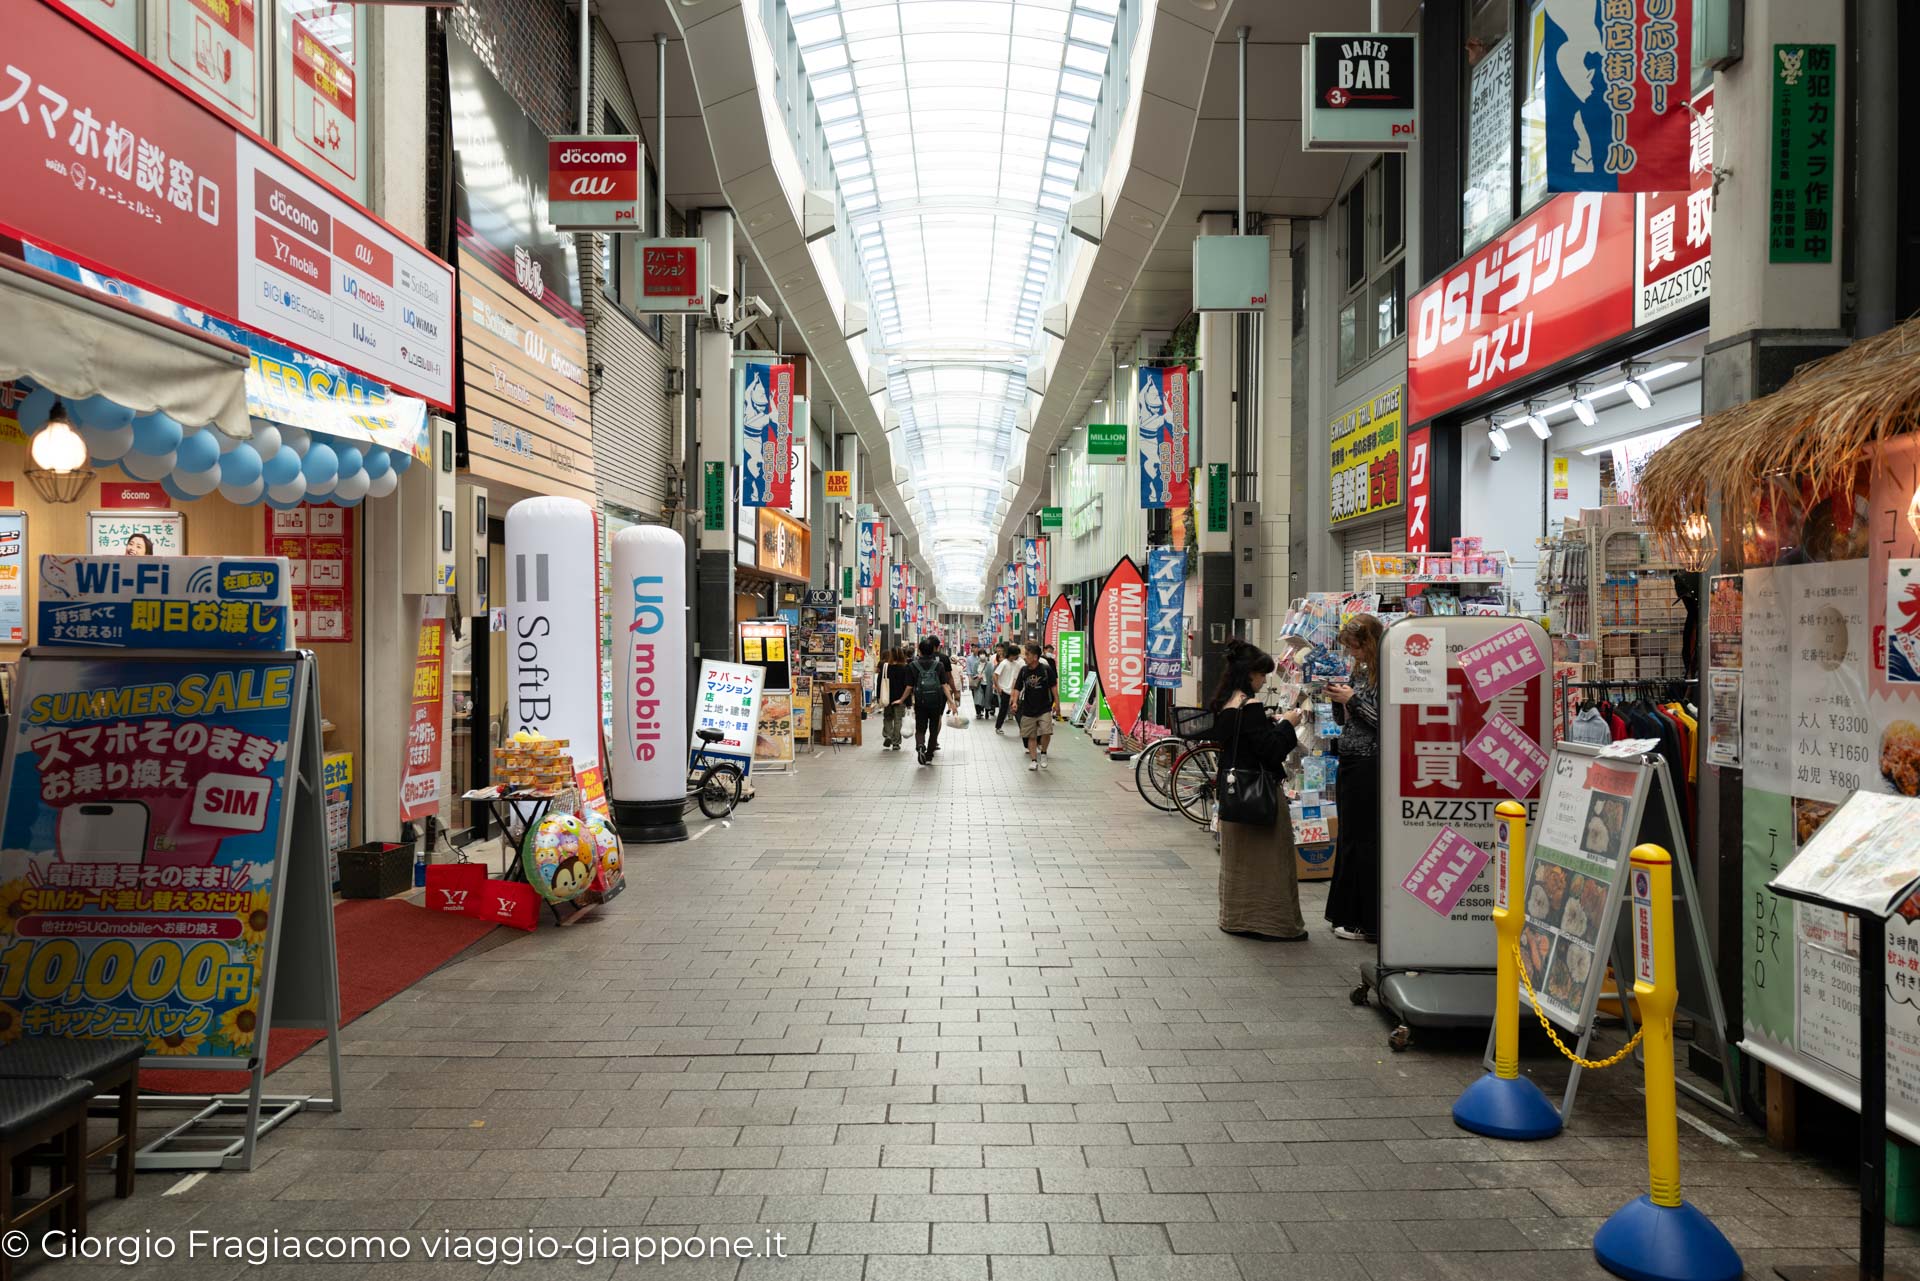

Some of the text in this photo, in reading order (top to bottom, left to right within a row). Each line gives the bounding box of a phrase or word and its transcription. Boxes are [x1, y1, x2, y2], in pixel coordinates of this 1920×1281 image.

[1341, 40, 1389, 60] DARTS
[1338, 59, 1390, 89] BAR
[1604, 0, 1637, 173] 商店街セール
[1391, 120, 1415, 136] pal
[1, 64, 219, 226] スマホ相談窓口
[560, 149, 627, 164] docomo
[1803, 48, 1830, 258] 防犯カメラ作動中
[45, 158, 68, 177] with
[569, 176, 616, 195] au
[269, 190, 319, 235] docomo
[615, 206, 635, 221] pal
[355, 244, 374, 265] au
[647, 251, 685, 263] アパート
[646, 264, 685, 276] マンション
[342, 274, 358, 300] UQ
[410, 275, 440, 306] SoftBank
[1251, 294, 1267, 304] pal
[687, 297, 704, 308] pal
[402, 306, 438, 337] UQ WiMAX
[524, 330, 548, 365] au
[551, 348, 582, 384] docomo
[1467, 310, 1534, 390] クスリ
[1374, 389, 1400, 421] VINTAGE
[1090, 433, 1126, 441] MILLION
[827, 476, 848, 485] ABC
[121, 489, 150, 500] docomo
[98, 523, 174, 536] こんなドコモを
[98, 535, 176, 548] 待っていた。
[76, 563, 170, 595] Wi-Fi
[222, 571, 275, 591] 在庫あり
[55, 605, 115, 626] 持ち運べて
[130, 599, 278, 634] 即日お渡し
[1152, 556, 1185, 655] スマスロ
[52, 625, 124, 640] すぐ使える!!
[1108, 588, 1119, 690] PACHINKO SLOT
[1120, 583, 1142, 696] MILLION
[1461, 627, 1528, 666] SUMMER
[629, 575, 664, 762] UQ mobile
[707, 670, 753, 684] アパート
[1067, 636, 1081, 698] MILLION
[1475, 646, 1537, 688] SALE
[28, 667, 293, 724] SUMMER SALE
[707, 681, 753, 696] マンション
[758, 720, 790, 730] 大ネタ
[1797, 713, 1869, 734] 大人 ¥3300
[31, 722, 276, 772] スマホそのまま
[1490, 716, 1549, 770] SUMMER
[1797, 740, 1869, 762] 小人 ¥1650
[1478, 736, 1536, 788] SALE
[41, 756, 190, 800] お乗り換え
[1797, 766, 1860, 791] 幼児 ¥880
[203, 787, 258, 816] SIM
[1402, 800, 1540, 820] BAZZSTE
[1463, 821, 1494, 829] Recycle
[1406, 830, 1457, 892] SUMMER
[50, 863, 232, 890] 電話番号そのまま!
[1426, 844, 1477, 905] SALE
[20, 889, 250, 912] SIMカード差し替えるだけ!
[41, 919, 219, 936] 他社からUQmobileへお乗り換え
[1755, 892, 1766, 989] BBQ
[1888, 932, 1919, 955] 3時間
[1, 939, 252, 1003] 10,000円
[22, 1003, 213, 1036] キャッシュバック
